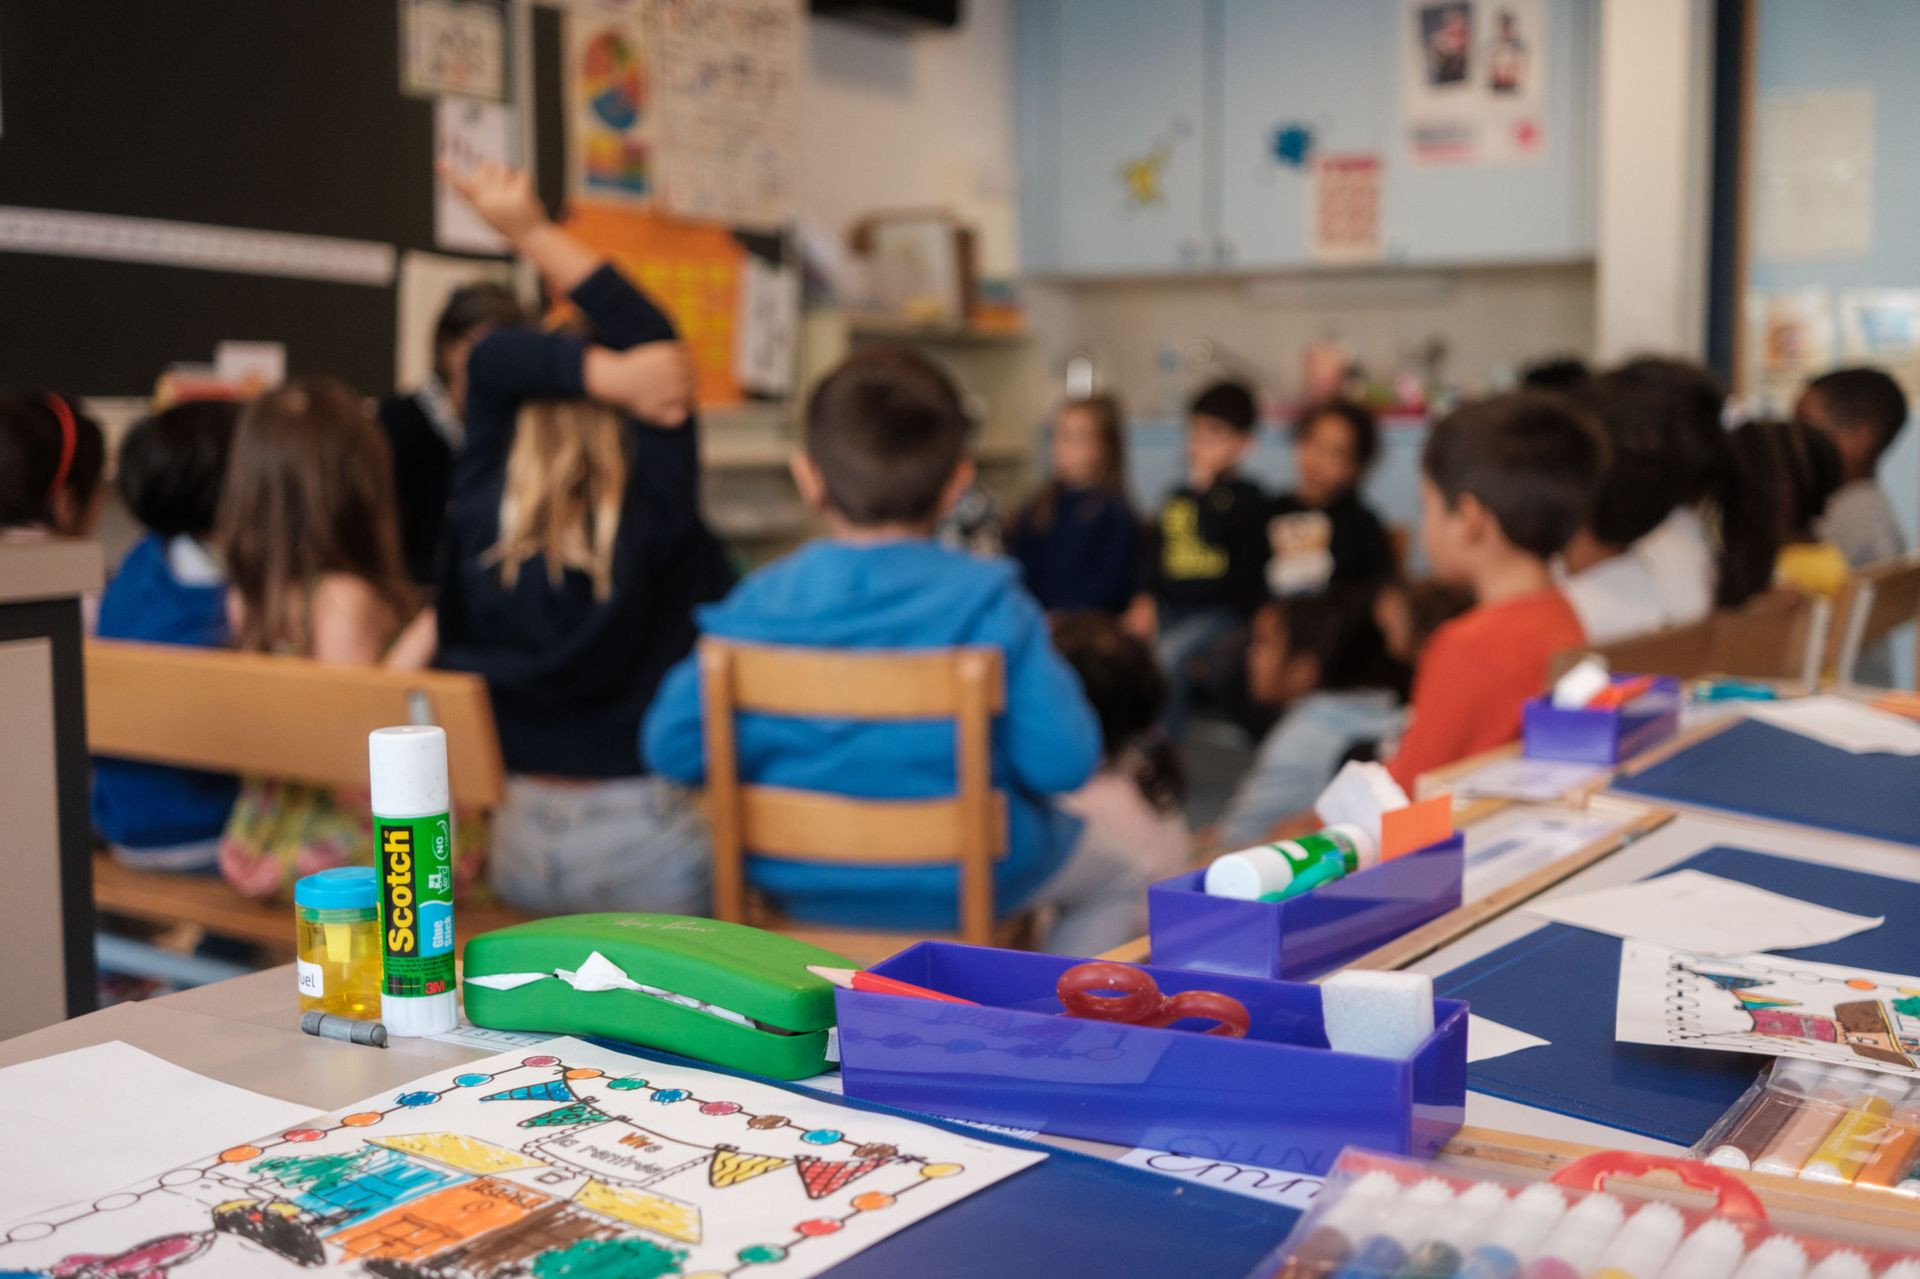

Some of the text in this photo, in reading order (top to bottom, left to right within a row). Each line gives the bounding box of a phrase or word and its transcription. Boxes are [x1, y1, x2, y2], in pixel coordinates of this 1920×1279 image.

[436, 836, 445, 855] NO
[384, 830, 415, 952] Scotch
[432, 919, 444, 948] Glue
[443, 915, 453, 947] Stick
[424, 979, 445, 995] 3M
